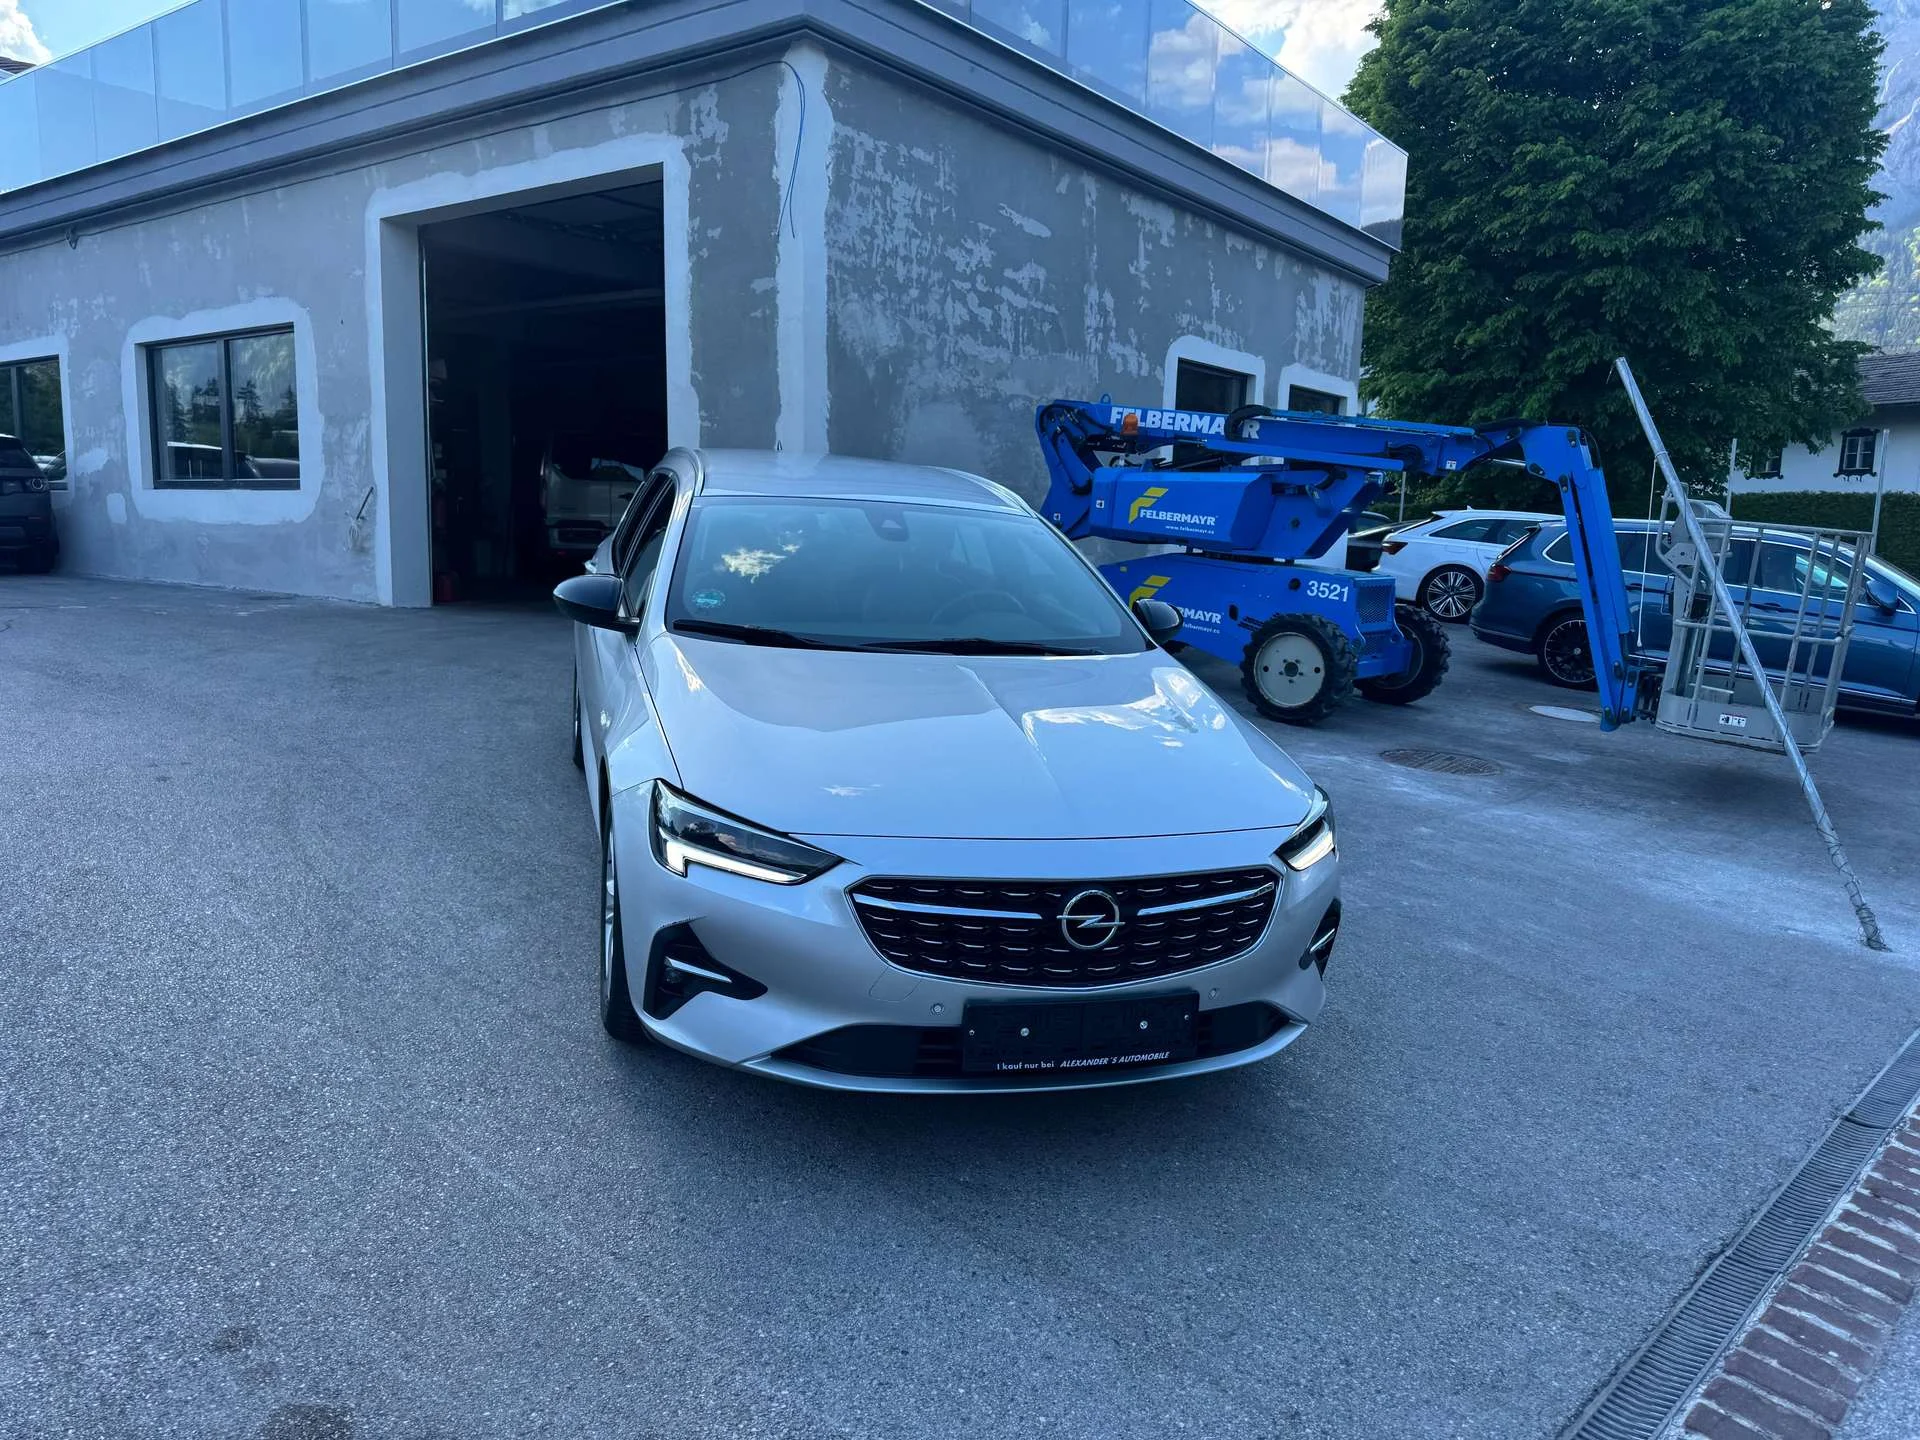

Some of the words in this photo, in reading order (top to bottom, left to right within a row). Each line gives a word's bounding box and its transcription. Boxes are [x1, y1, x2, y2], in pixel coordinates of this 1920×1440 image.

[1110, 406, 1260, 440] FLBERMAR
[1140, 509, 1216, 526] FELBERMAYR
[1306, 580, 1349, 602] 3521
[1002, 1061, 1022, 1070] kauf
[1041, 1060, 1054, 1068] bei
[1118, 1051, 1170, 1063] AUTOMOBILE
